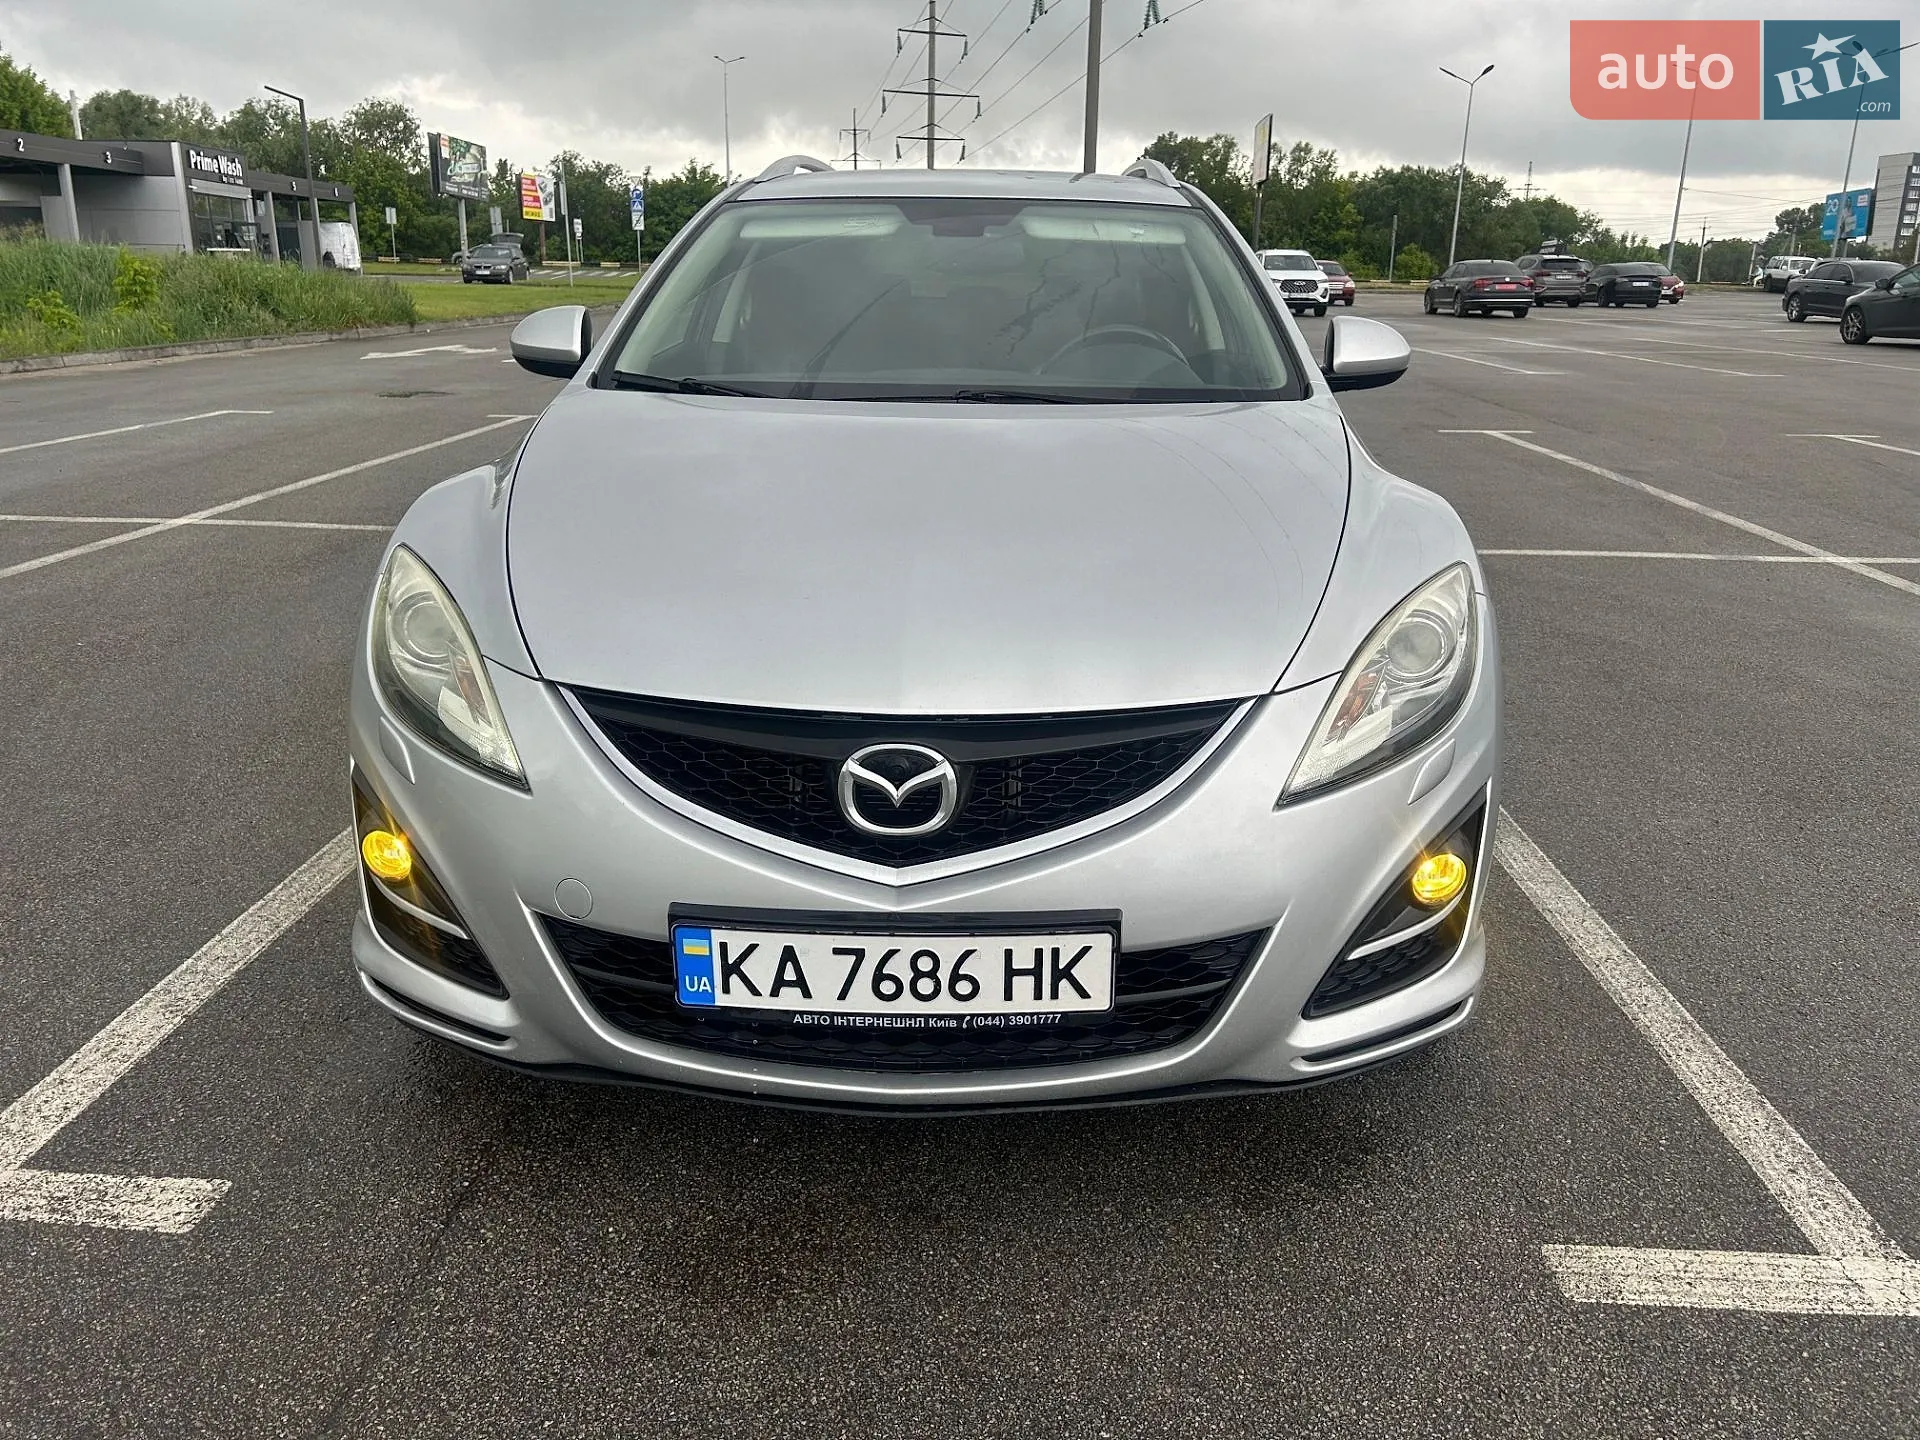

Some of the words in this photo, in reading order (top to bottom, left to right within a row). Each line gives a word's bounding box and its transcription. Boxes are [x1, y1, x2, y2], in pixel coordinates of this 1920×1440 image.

[17, 138, 25, 152] 2
[105, 151, 112, 164] 3
[189, 149, 219, 173] Prime
[217, 154, 243, 177] Wash
[719, 941, 813, 999] KA
[832, 947, 980, 1002] 7686
[1003, 945, 1093, 1001] HK
[685, 976, 712, 994] UA
[793, 1014, 830, 1026] АВТО
[834, 1016, 925, 1028] ІНТЕРНЕШНЛ
[929, 1016, 957, 1028] Київ
[973, 1015, 1005, 1027] (044)
[1009, 1013, 1062, 1026] 3901777
